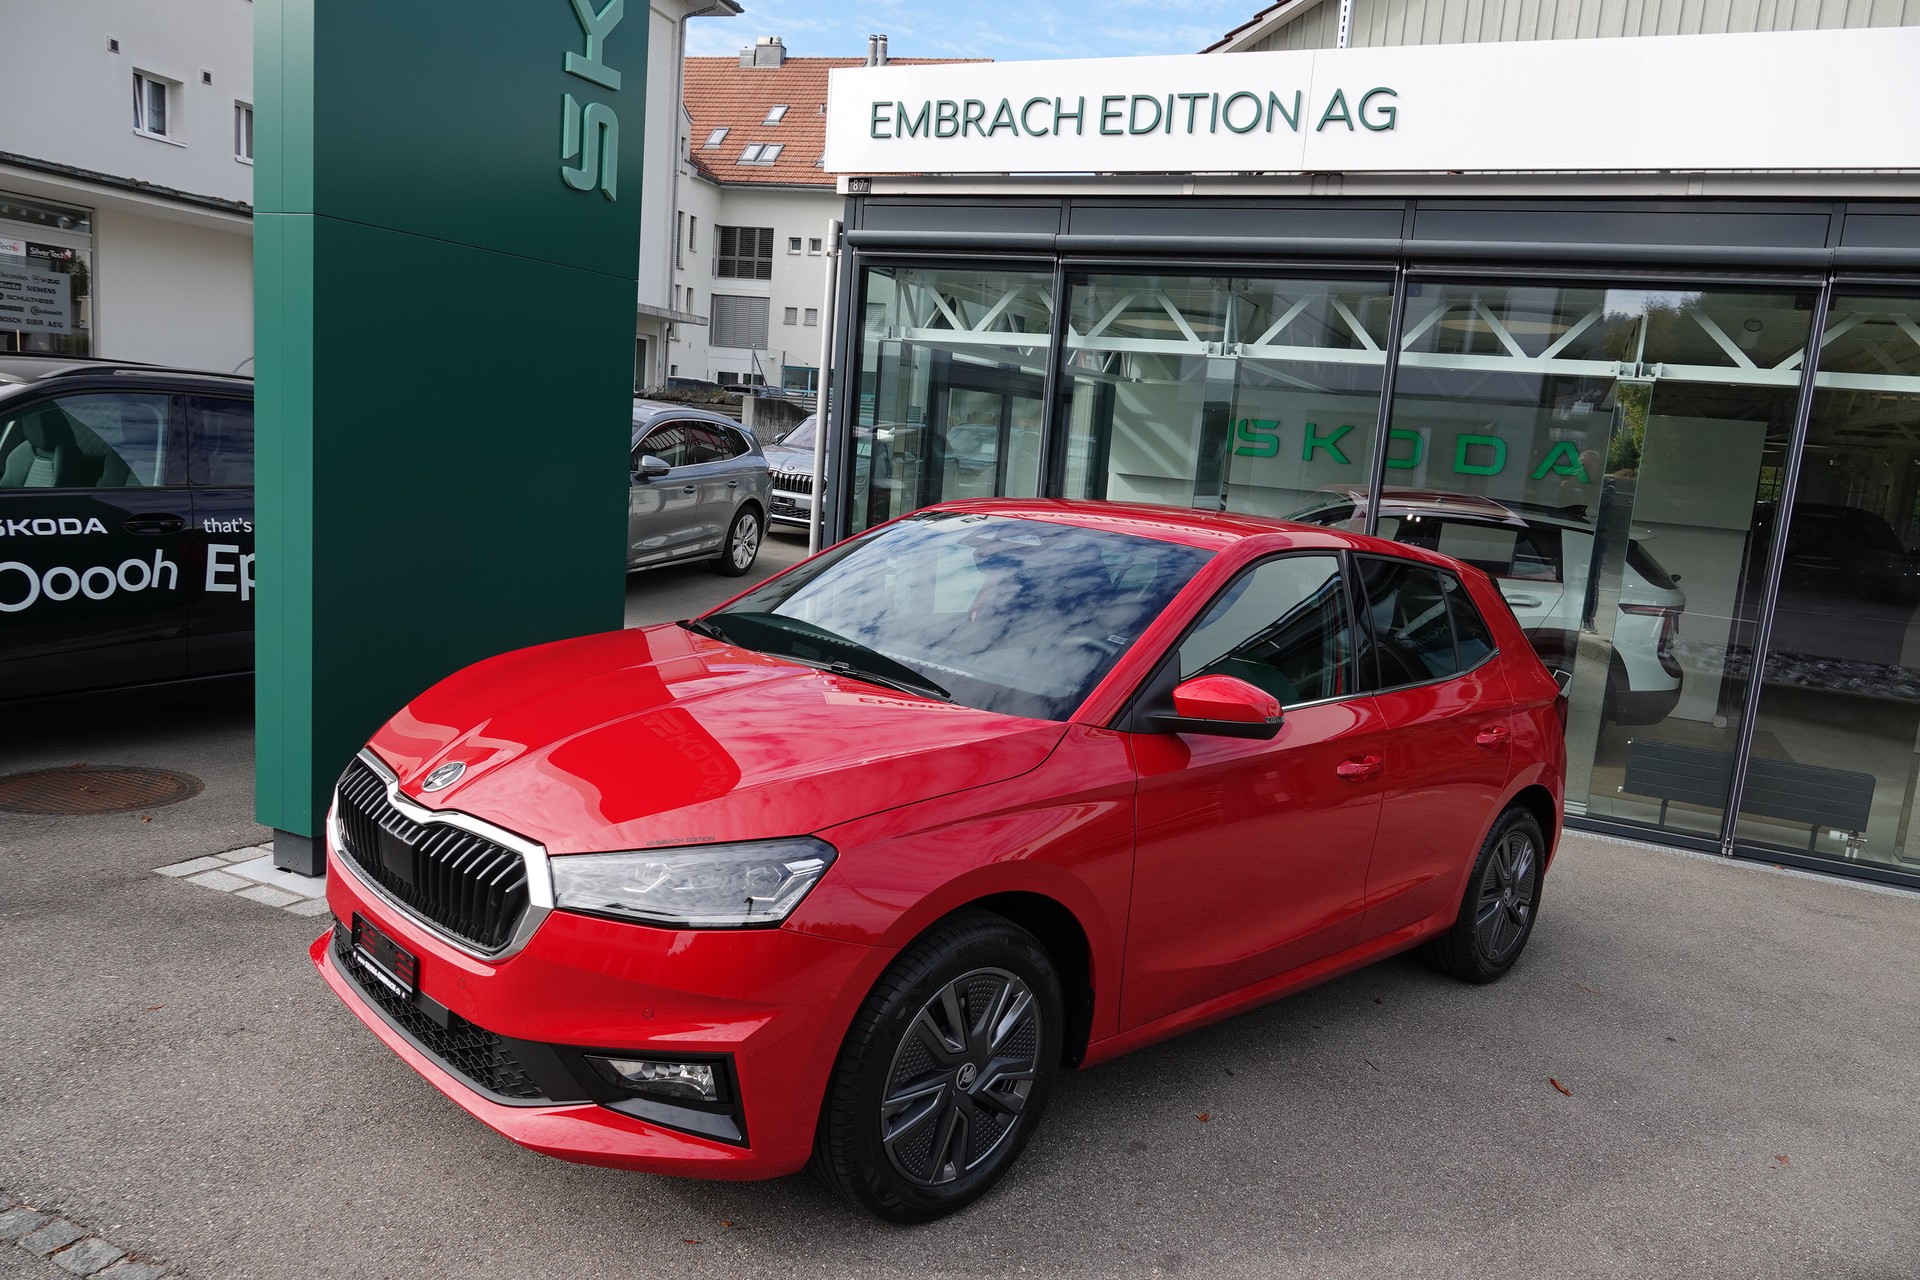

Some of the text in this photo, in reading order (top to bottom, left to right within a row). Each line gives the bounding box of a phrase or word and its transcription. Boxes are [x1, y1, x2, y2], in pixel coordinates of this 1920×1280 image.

[870, 86, 1398, 139] EMBRACH EDITION AG
[852, 179, 865, 191] 87
[26, 285, 56, 294] SIEMENS
[6, 294, 54, 304] SCHULTHESS
[47, 320, 63, 328] AEG
[1233, 417, 1592, 484] SKODA
[203, 517, 253, 533] that's
